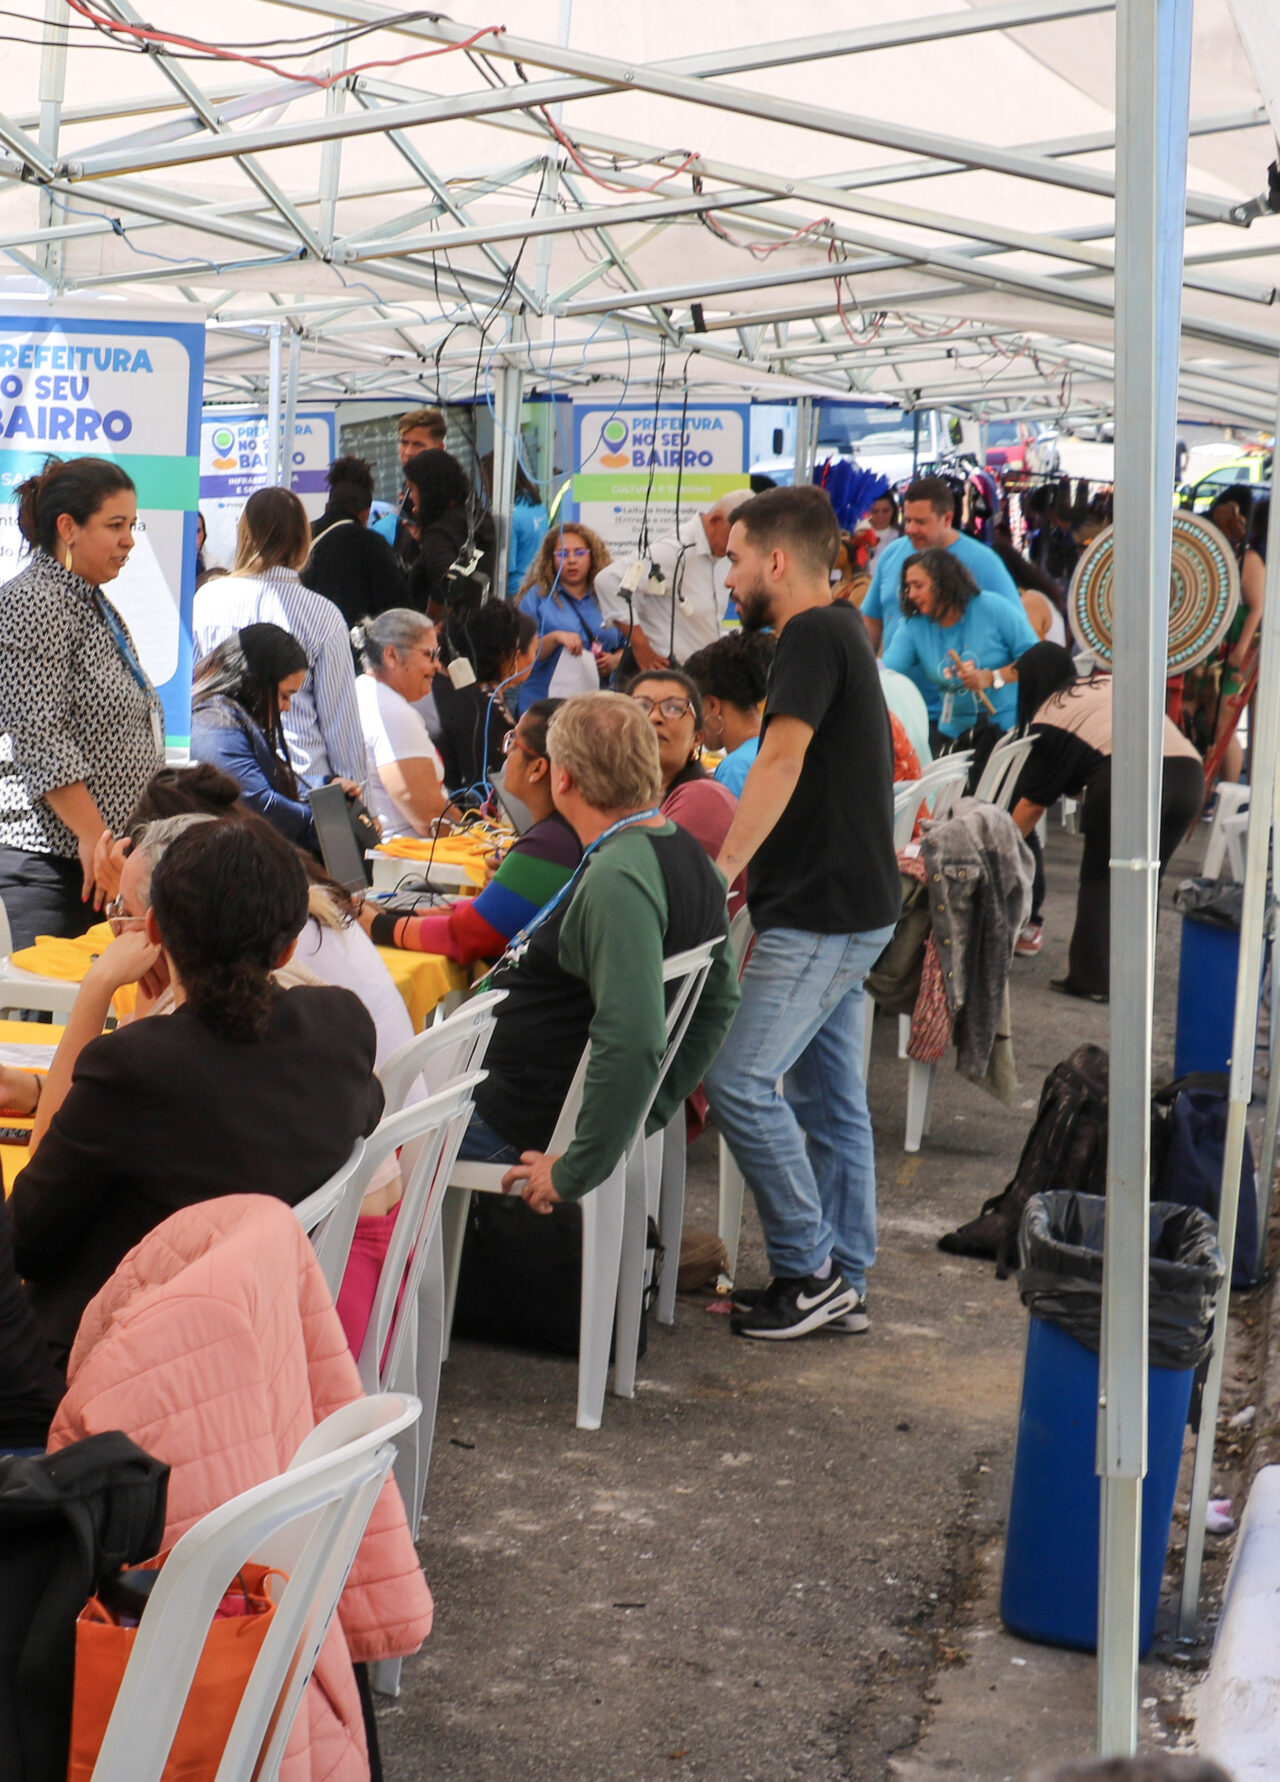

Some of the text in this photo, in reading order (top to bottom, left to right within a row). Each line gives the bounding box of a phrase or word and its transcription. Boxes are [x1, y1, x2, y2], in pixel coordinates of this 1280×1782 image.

[35, 375, 90, 401] SEU
[632, 417, 723, 431] PREFEITURA
[238, 440, 257, 451] NO
[632, 433, 690, 447] NO SEU
[632, 450, 713, 467] BAIRRO
